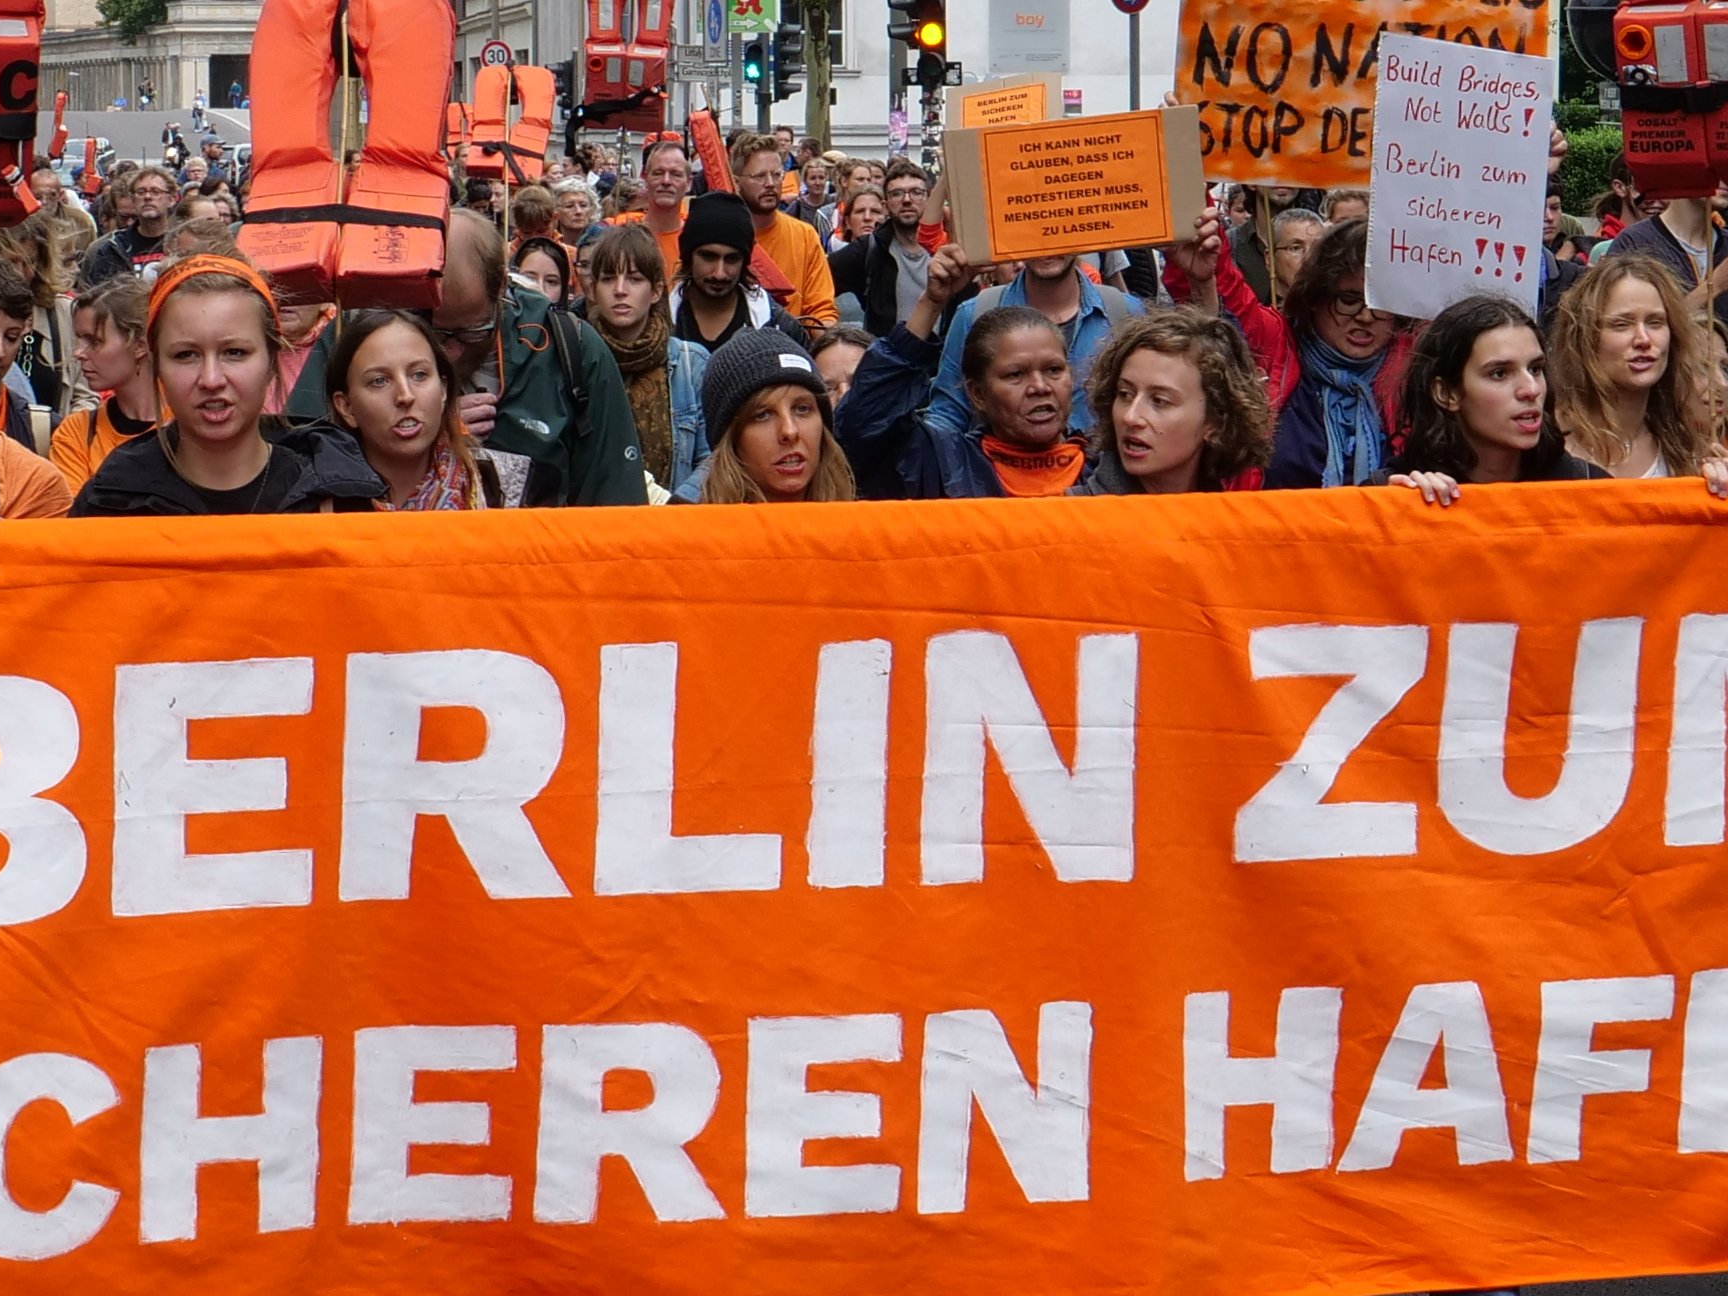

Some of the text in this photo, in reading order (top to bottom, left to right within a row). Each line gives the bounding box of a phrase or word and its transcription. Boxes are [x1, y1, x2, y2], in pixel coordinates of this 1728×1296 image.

[487, 49, 506, 64] 30
[1192, 21, 1292, 94] NO
[1386, 55, 1540, 109] Build Bridges,
[977, 92, 1028, 107] BERLIN ZUM
[981, 104, 1024, 116] SICHEREN
[988, 114, 1017, 124] HAFEN
[1404, 97, 1442, 124] Not
[1637, 118, 1679, 128] COSALT
[1631, 130, 1686, 139] PREMIER
[1019, 134, 1122, 154] ICH KANN NICHT
[1629, 140, 1695, 153] EUROPA
[1010, 150, 1135, 171] GLAUBEN, DASS ICH
[1385, 143, 1527, 186] Berlin zum
[1044, 170, 1104, 185] DAGEGEN
[1007, 183, 1144, 206] PROTESTIEREN MUSS,
[1004, 199, 1149, 223] MENSCHEN ERTRINKEN
[1406, 197, 1502, 230] sicheren
[1042, 220, 1115, 236] ZU LASSEN.
